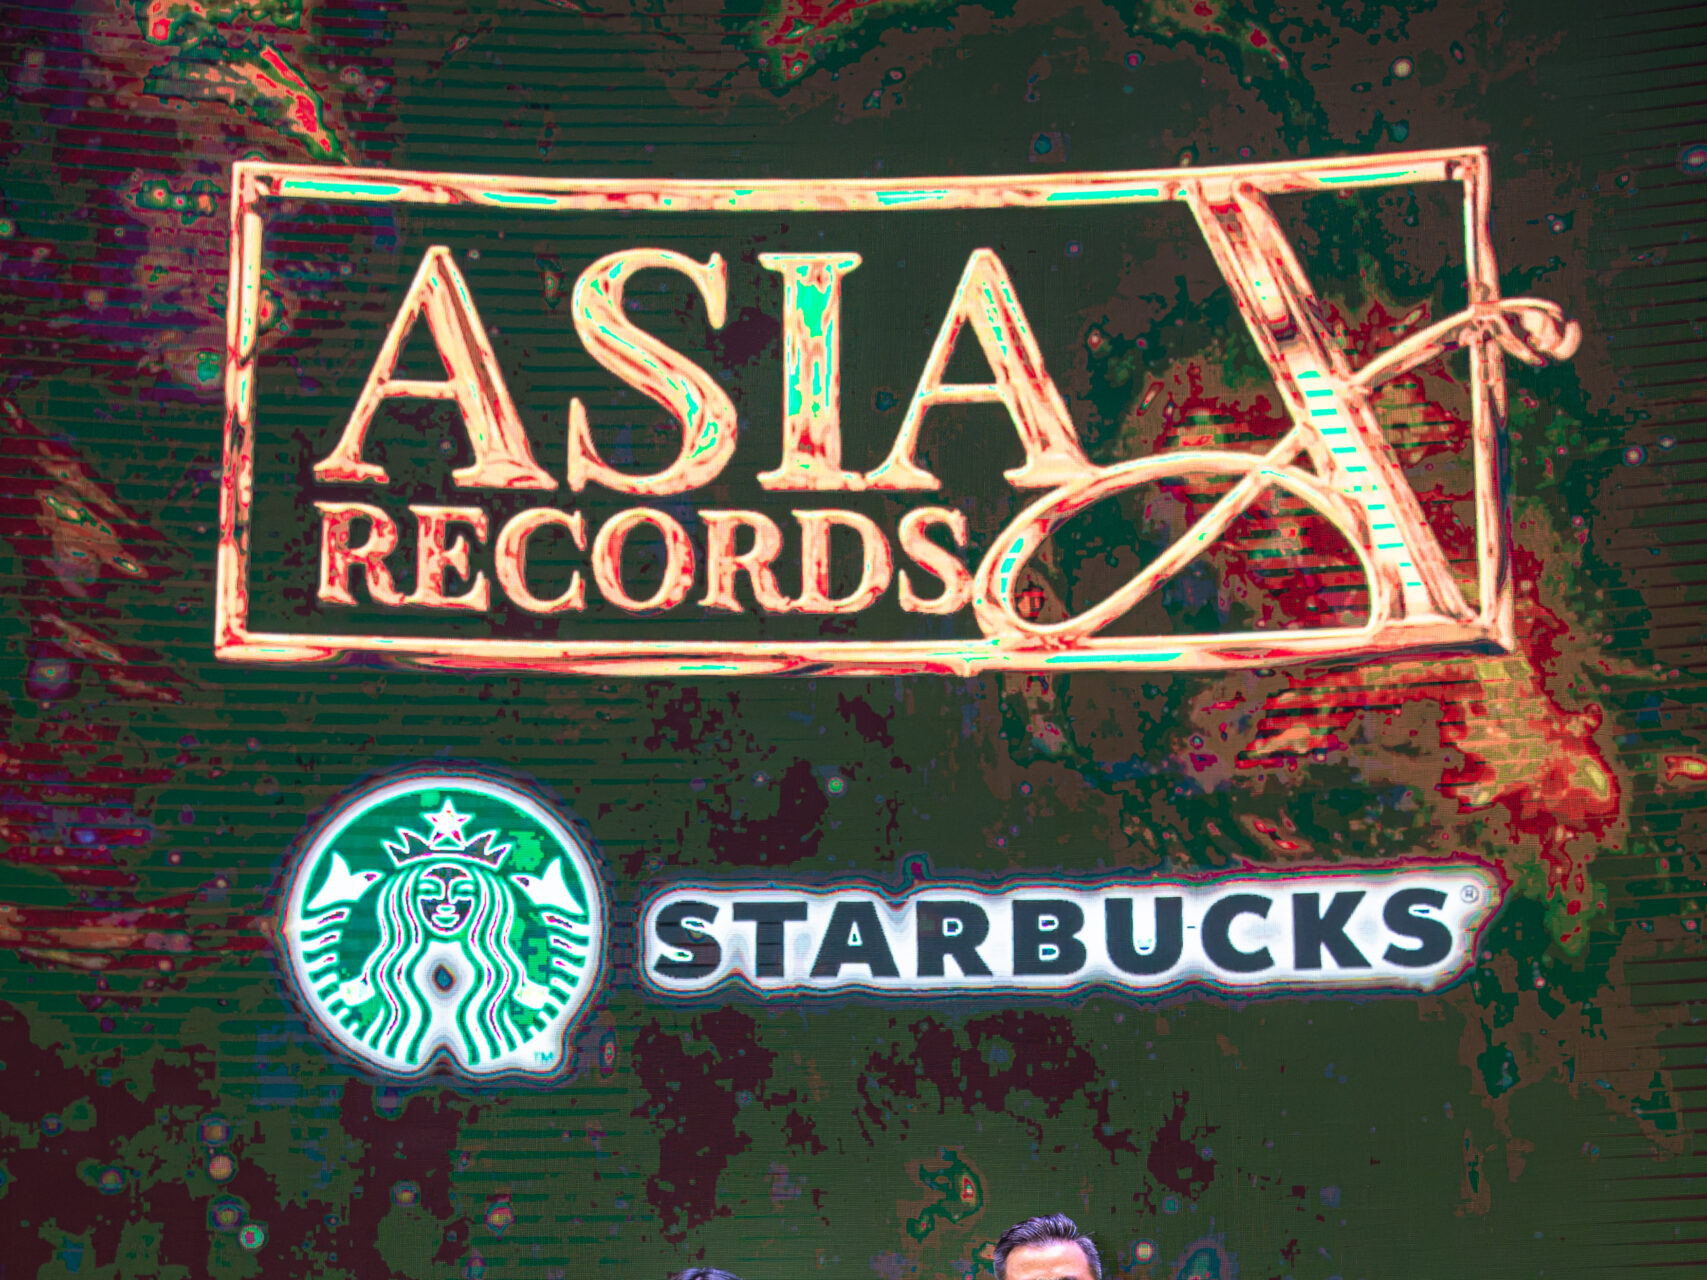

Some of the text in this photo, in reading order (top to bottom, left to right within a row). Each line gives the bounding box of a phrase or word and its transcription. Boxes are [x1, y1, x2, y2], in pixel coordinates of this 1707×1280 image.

[314, 245, 1092, 494] ASIA
[314, 502, 970, 614] RECORDS
[652, 886, 1453, 980] STARBUCKS
